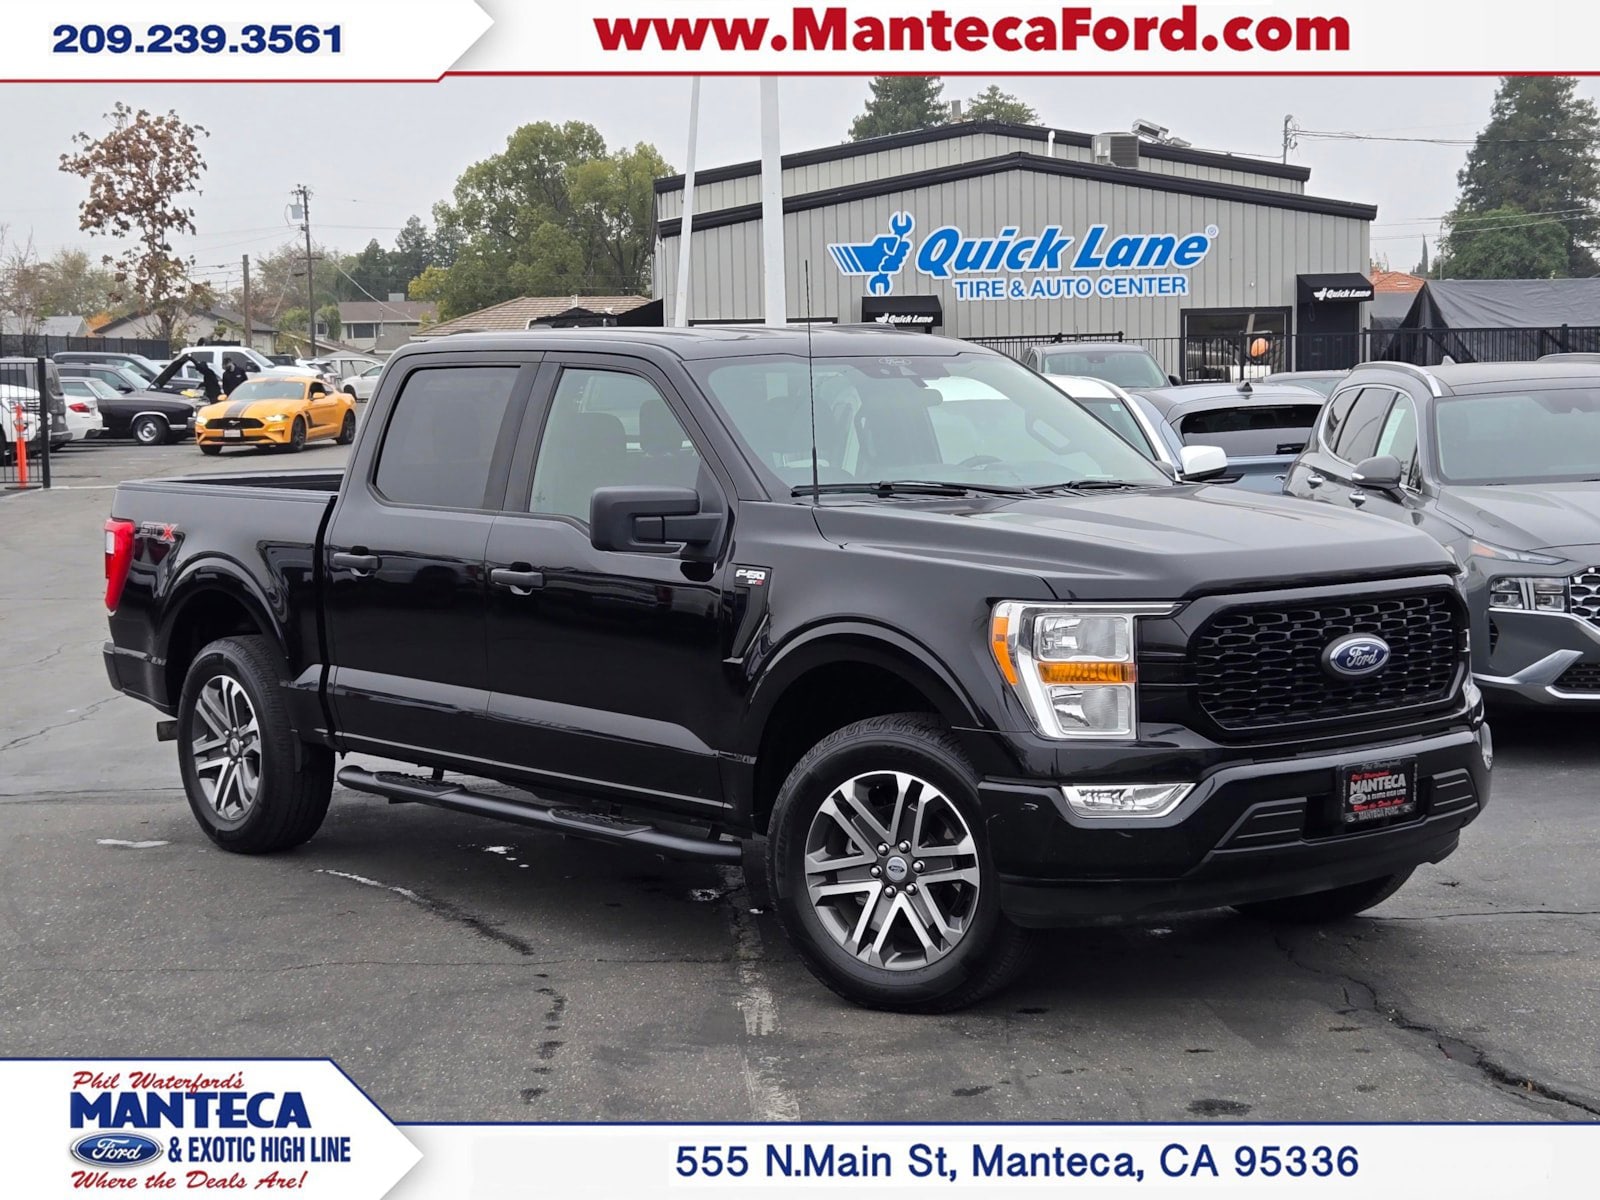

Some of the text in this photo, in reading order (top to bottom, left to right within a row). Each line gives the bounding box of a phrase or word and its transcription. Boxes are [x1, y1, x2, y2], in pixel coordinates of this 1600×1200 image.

[917, 226, 1209, 278] Quick Lane
[956, 276, 1186, 298] TIRE & AUTO CENTER
[1326, 289, 1372, 299] Quick Lane
[888, 314, 912, 324] Quick
[1346, 645, 1379, 667] Ford
[1349, 773, 1407, 795] MANTECA
